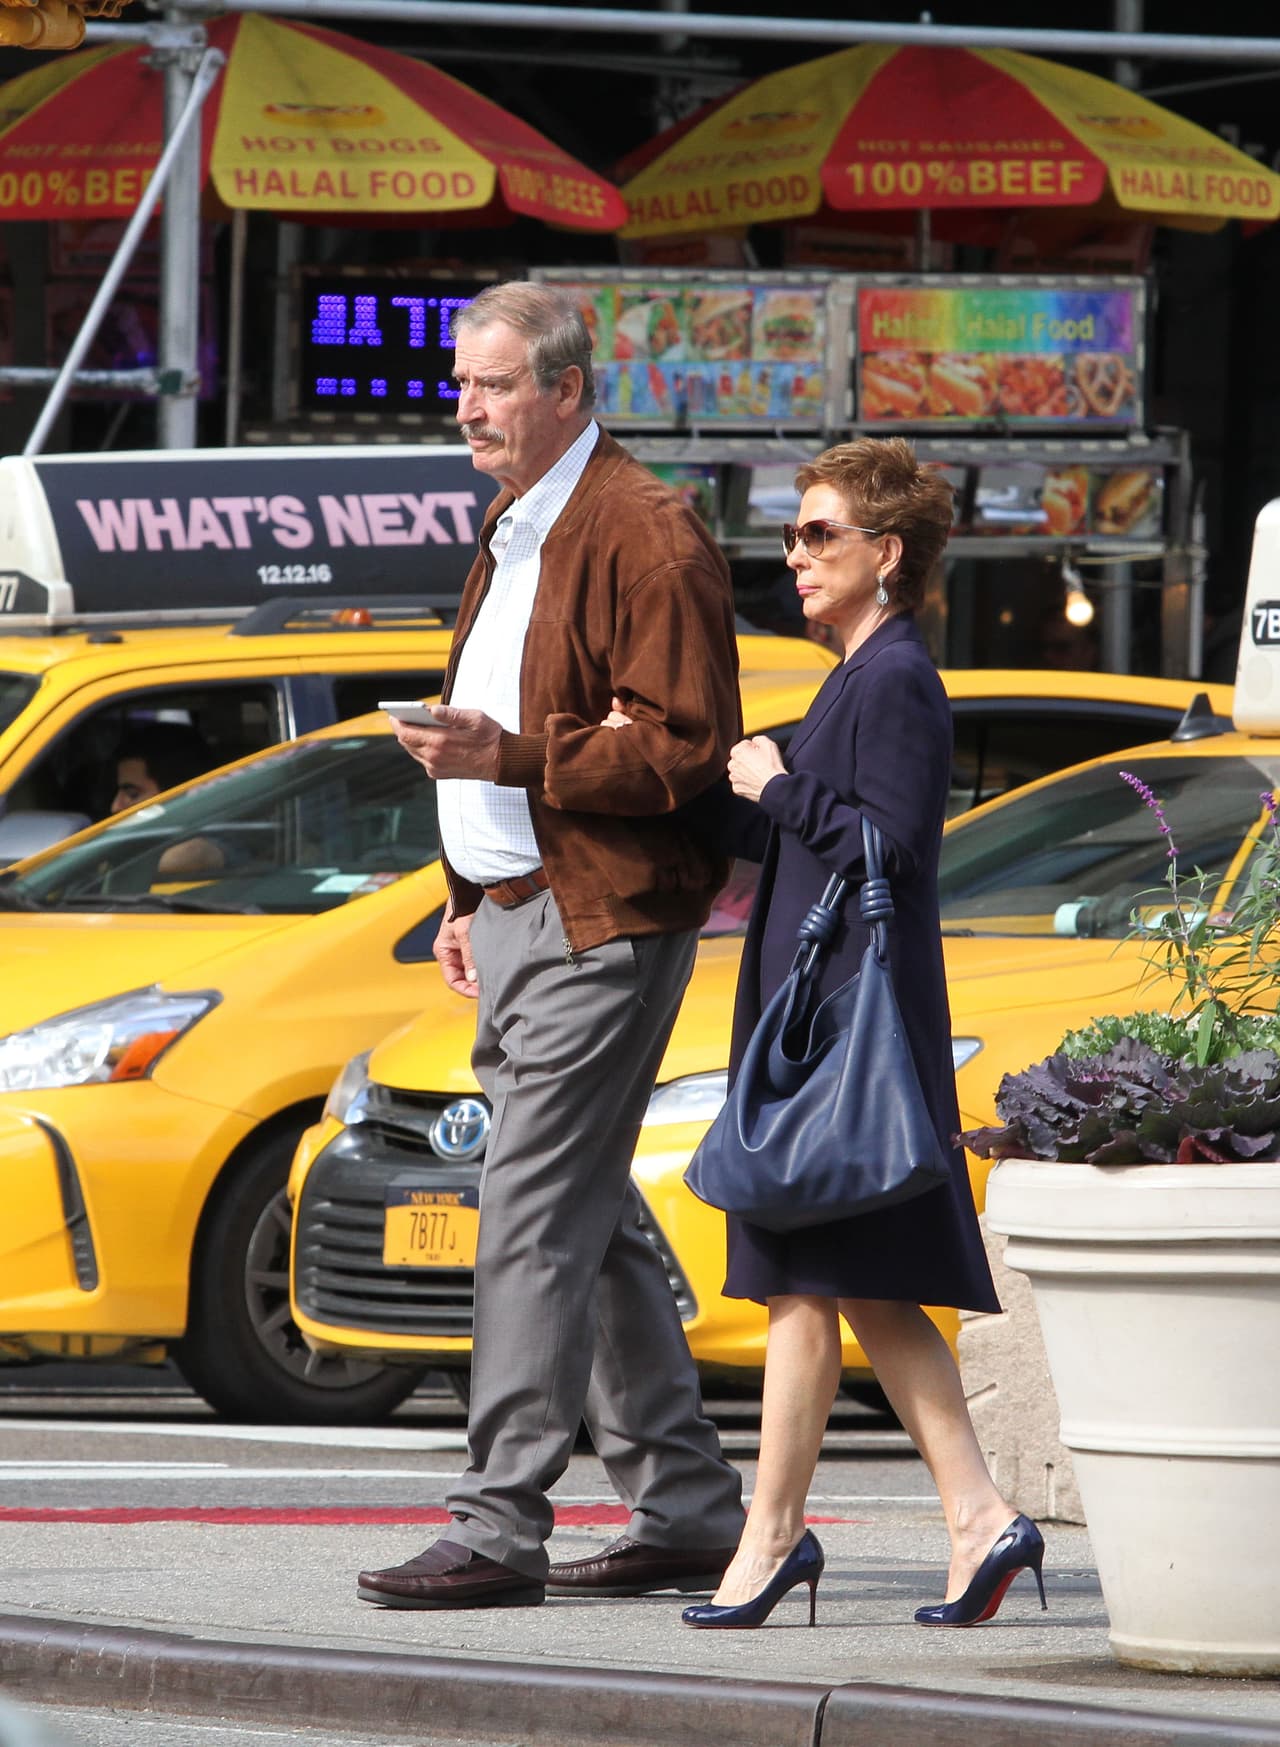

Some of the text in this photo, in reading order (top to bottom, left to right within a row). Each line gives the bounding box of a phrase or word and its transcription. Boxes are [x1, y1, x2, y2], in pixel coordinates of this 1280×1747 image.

[241, 136, 443, 155] HOT DOGS
[857, 139, 911, 152] HOT
[234, 167, 476, 200] HALAL FOOD
[847, 159, 1085, 196] 100%BEEF
[1120, 167, 1272, 208] HALAL FOOD
[629, 174, 811, 224] HALAL FOOD
[964, 313, 1025, 340] Halal
[1032, 313, 1095, 341] Food
[76, 492, 477, 551] WHAT'S NEXT
[257, 563, 333, 584] 12.12.16
